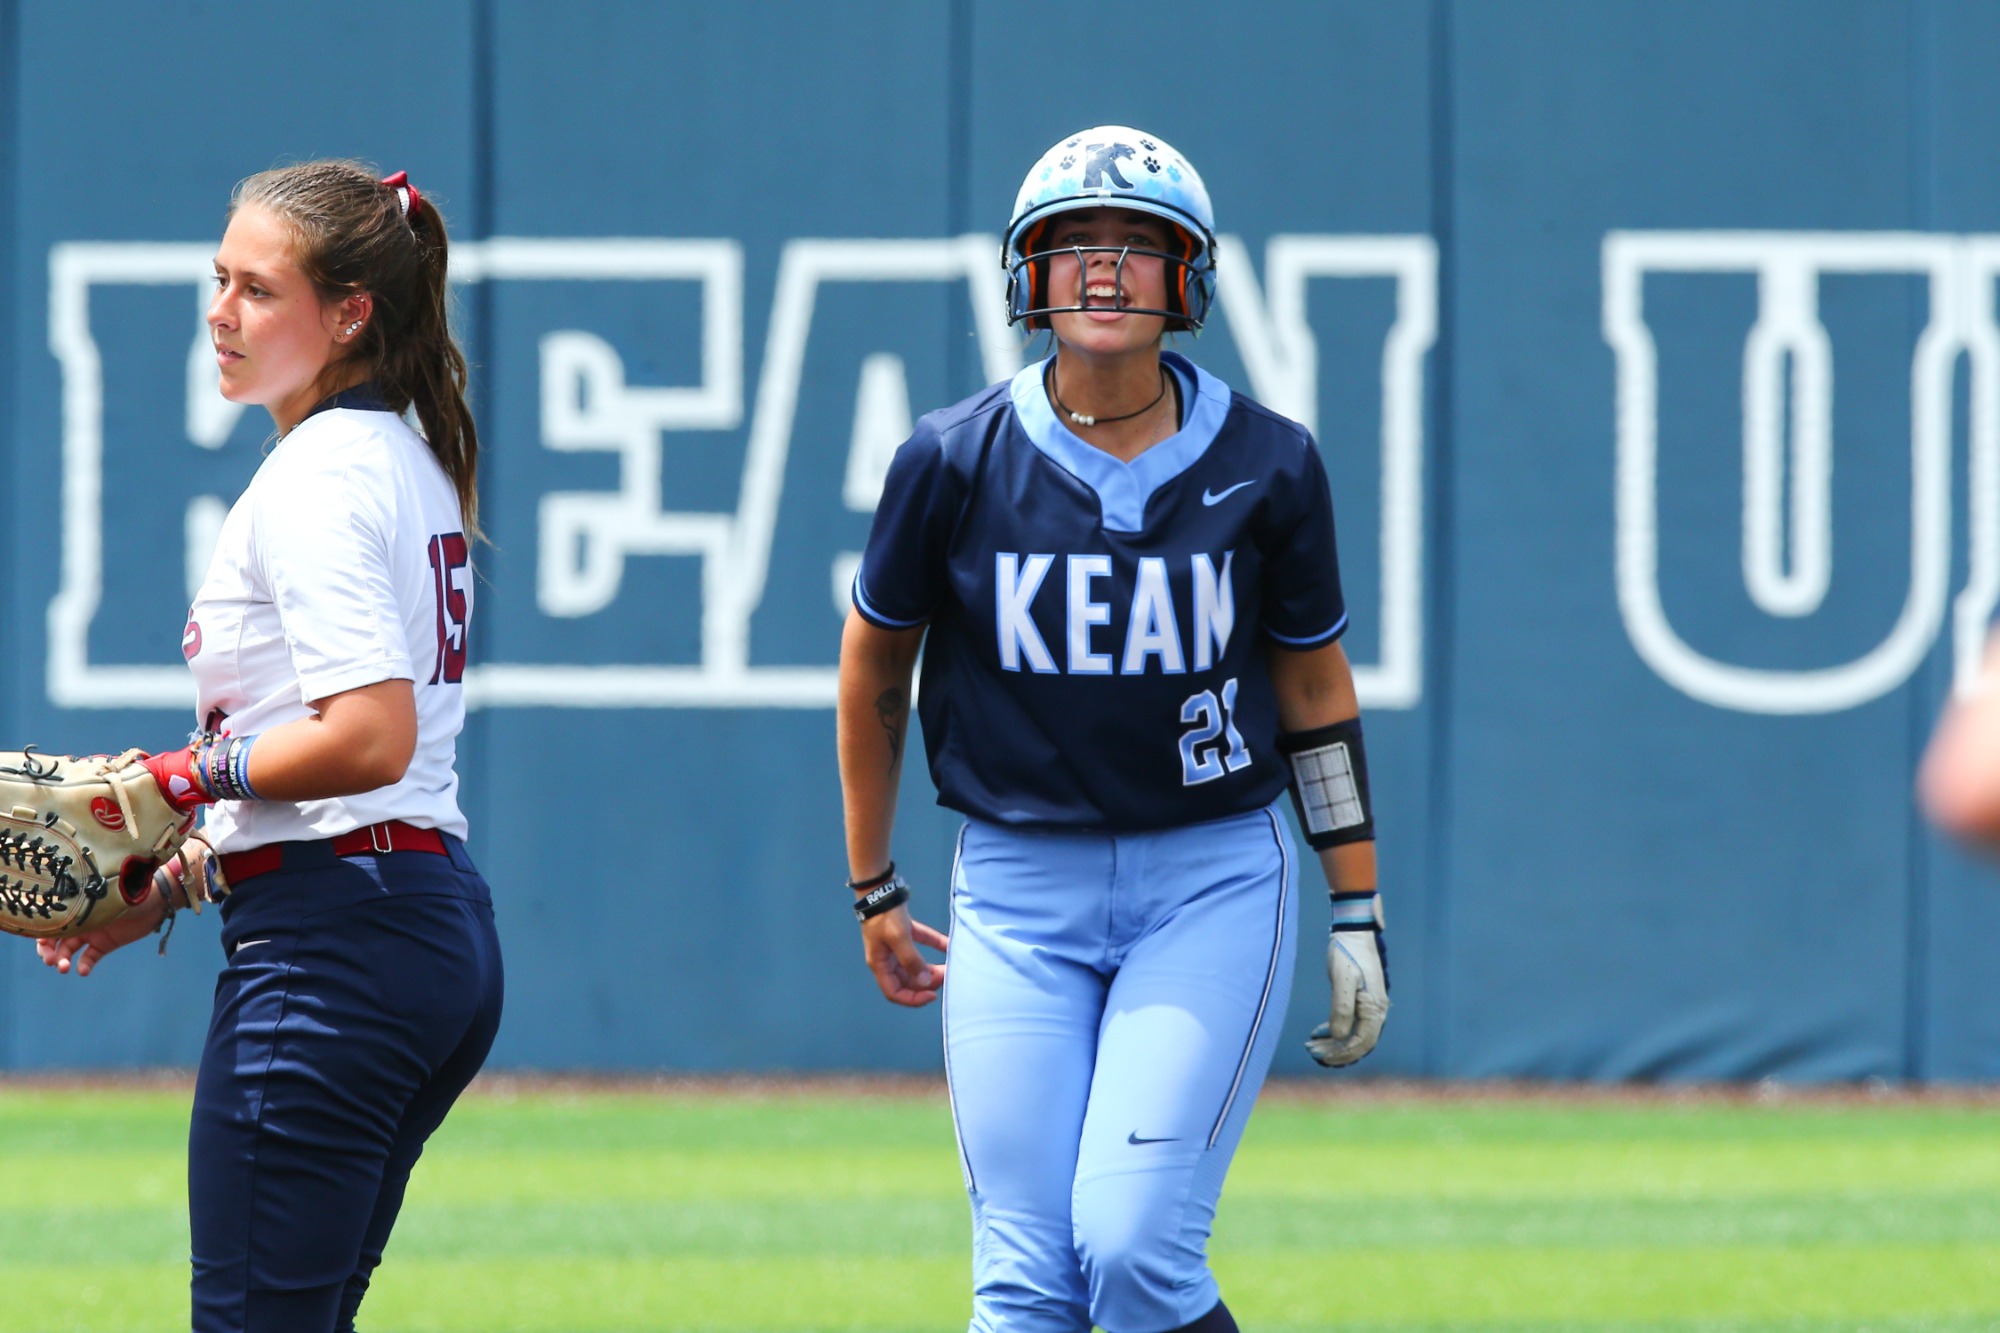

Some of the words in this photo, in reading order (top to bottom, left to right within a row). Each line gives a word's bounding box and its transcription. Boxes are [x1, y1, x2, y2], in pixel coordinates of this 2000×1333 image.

[428, 531, 468, 685] 15
[995, 549, 1236, 676] KEAN
[228, 758, 239, 785] MORE
[1178, 677, 1253, 786] 21
[865, 880, 896, 905] RALLY
